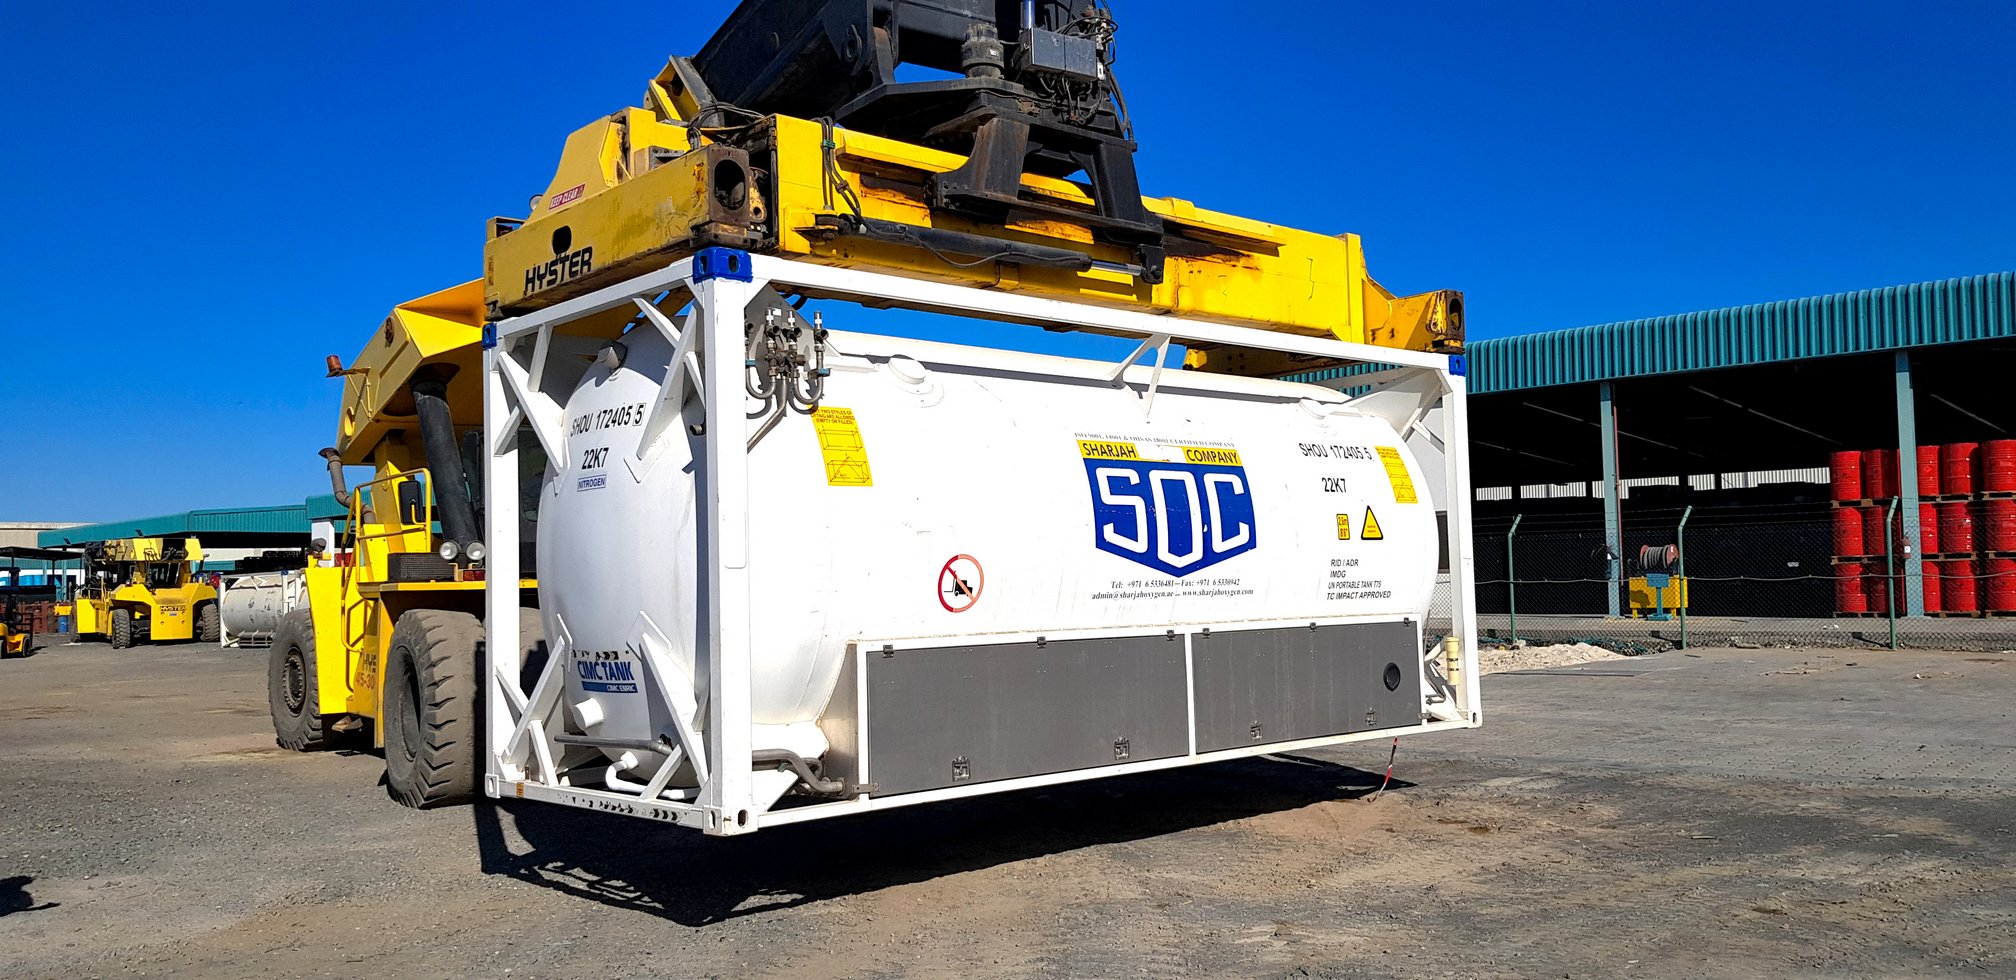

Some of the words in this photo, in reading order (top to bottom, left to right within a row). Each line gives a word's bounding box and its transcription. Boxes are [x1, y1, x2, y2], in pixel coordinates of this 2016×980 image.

[524, 246, 593, 293] HYSTER
[570, 413, 593, 437] SHOU
[596, 405, 633, 430] 172405
[634, 404, 644, 424] 5
[582, 447, 609, 469] 22K7
[1083, 443, 1137, 459] SHARJAH
[1187, 450, 1238, 464] COMPANY
[1299, 443, 1328, 458] SHOU
[1330, 445, 1363, 460] 172405
[1363, 447, 1372, 460] 5
[578, 478, 605, 488] NITROGEN
[1322, 477, 1346, 493] 22K7
[1095, 467, 1250, 568] SOC
[1330, 559, 1341, 567] RID
[1345, 559, 1359, 567] ADR
[1330, 570, 1346, 578] IMDG
[1111, 581, 1123, 589] Tel:
[1127, 580, 1142, 588] +971
[1328, 581, 1335, 589] UN
[1335, 581, 1360, 589] PORTABLE
[1327, 592, 1335, 600] TC
[1335, 591, 1359, 600] IMPACT
[1359, 590, 1391, 599] APPROVED
[577, 660, 603, 681] CIMC
[601, 661, 635, 681] TANK
